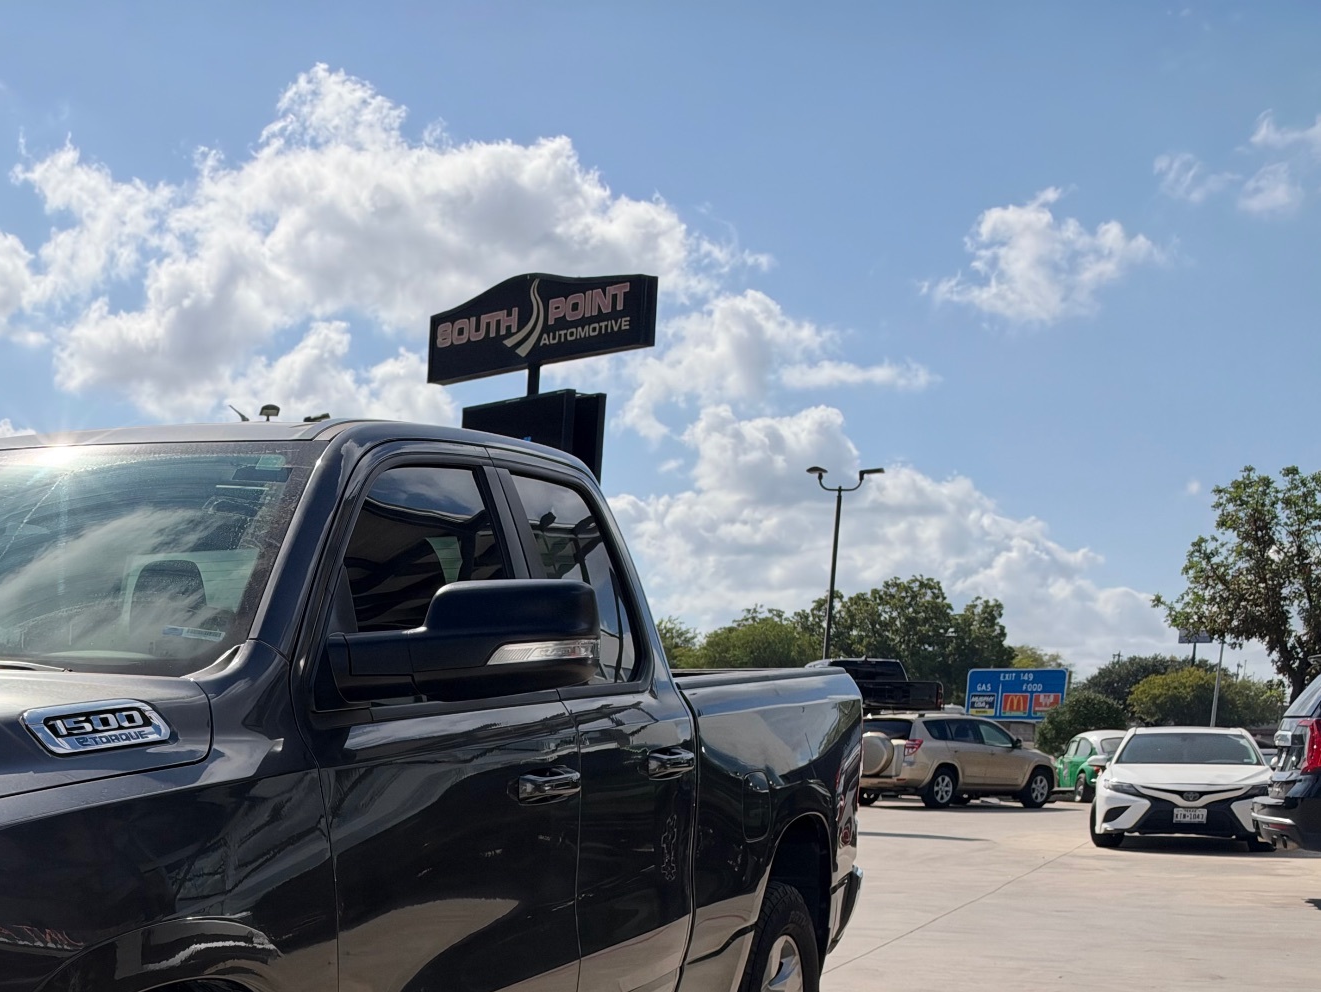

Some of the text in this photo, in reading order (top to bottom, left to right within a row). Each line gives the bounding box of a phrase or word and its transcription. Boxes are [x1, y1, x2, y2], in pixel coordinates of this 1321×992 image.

[436, 281, 631, 348] SOUTH POINT
[539, 316, 631, 347] AUTOMOTIVE
[999, 673, 1034, 681] EXIT 149
[976, 683, 992, 692] GAS
[1022, 683, 1043, 692] FOOD
[49, 711, 145, 736] 1500
